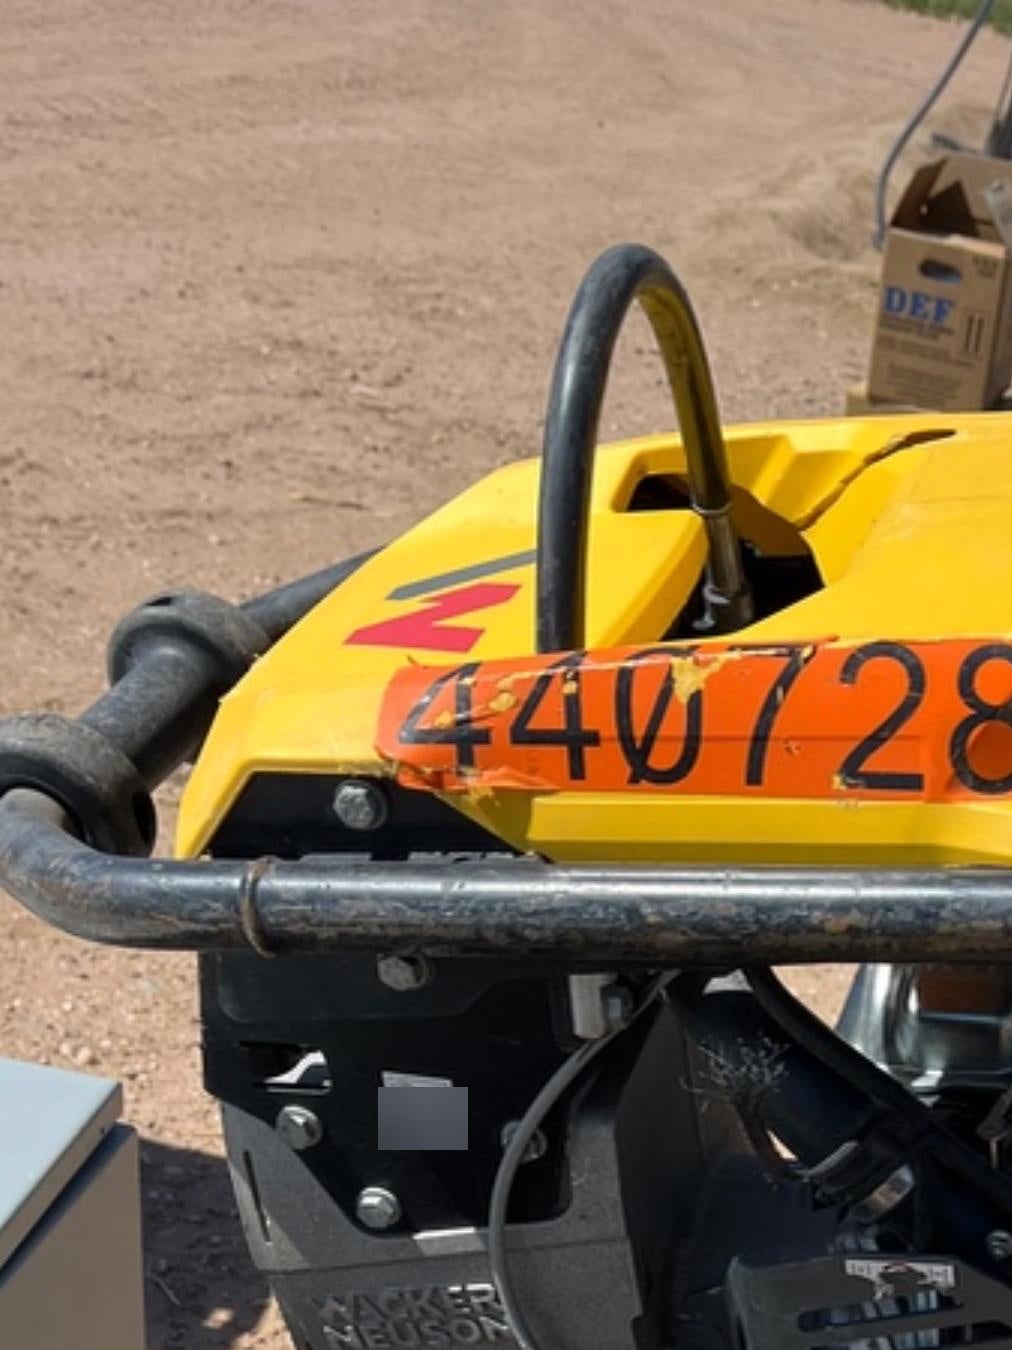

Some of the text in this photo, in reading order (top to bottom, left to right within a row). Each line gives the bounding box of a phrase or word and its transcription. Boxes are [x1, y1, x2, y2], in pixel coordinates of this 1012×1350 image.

[884, 286, 956, 324] DEF
[314, 1283, 501, 1321] WACKER
[323, 1314, 509, 1349] NEUSON
